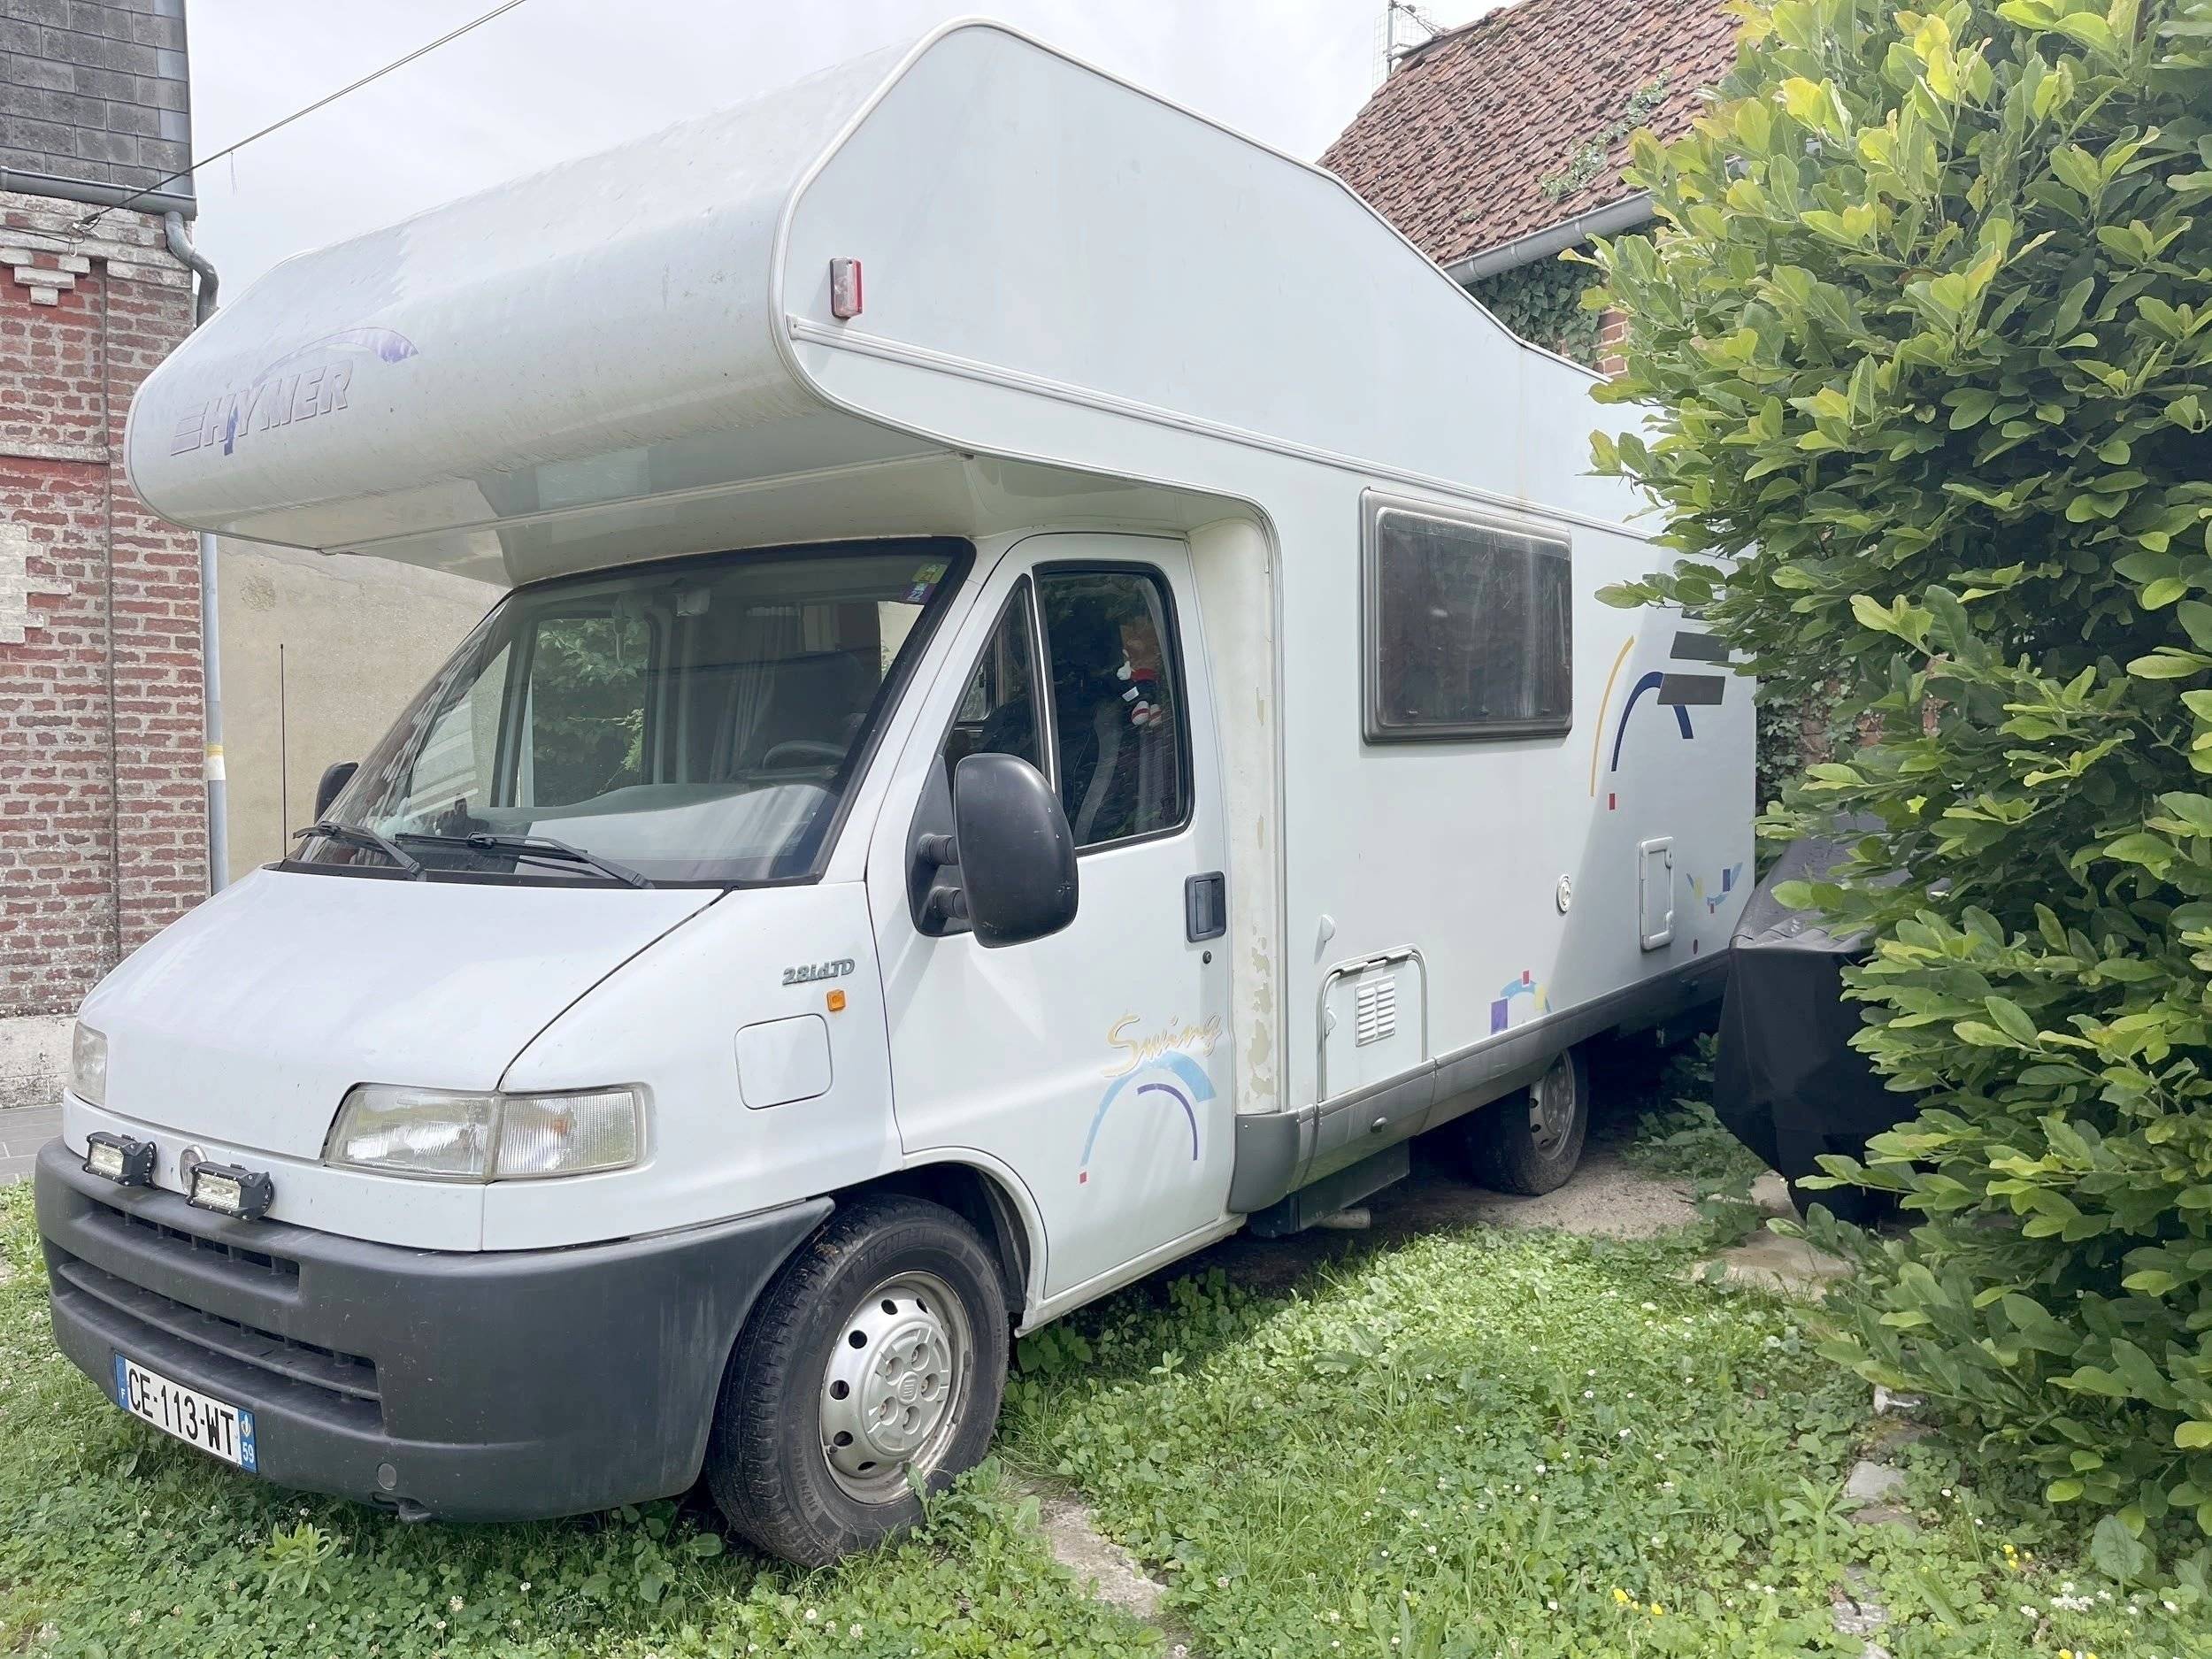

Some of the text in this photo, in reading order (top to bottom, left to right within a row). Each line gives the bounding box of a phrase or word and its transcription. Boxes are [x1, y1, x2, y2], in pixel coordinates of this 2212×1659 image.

[202, 358, 354, 449] HYMER
[1104, 1013, 1223, 1078] Swing
[128, 1368, 234, 1455] CE-113-WT
[242, 1443, 255, 1463] 59
